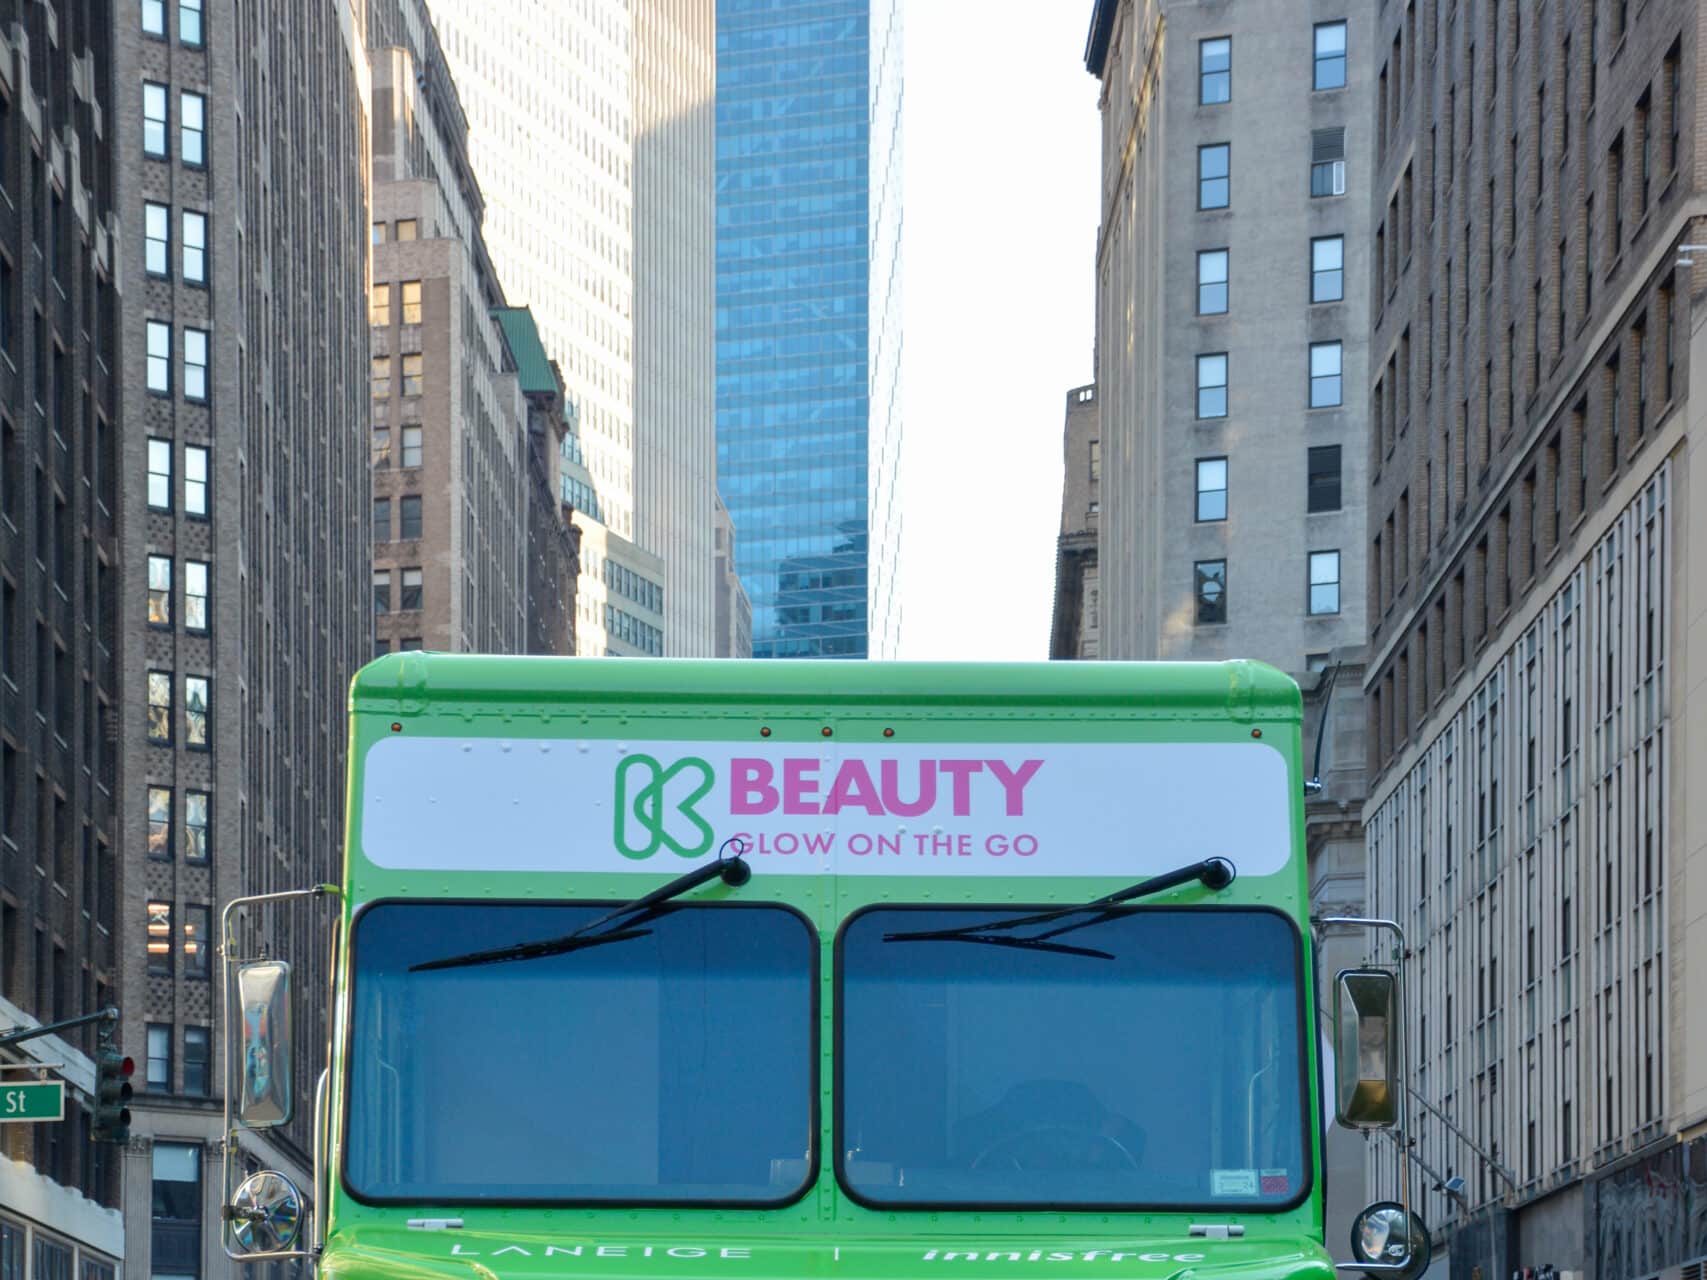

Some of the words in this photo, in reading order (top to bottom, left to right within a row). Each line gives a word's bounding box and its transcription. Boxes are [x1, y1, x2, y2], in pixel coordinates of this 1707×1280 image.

[730, 758, 1045, 817] BEAUTY
[730, 832, 835, 855] GLOW
[848, 833, 900, 856] ON
[914, 834, 972, 856] THE
[984, 834, 1039, 857] GO
[5, 1090, 26, 1113] St
[922, 1249, 1206, 1263] innisfree
